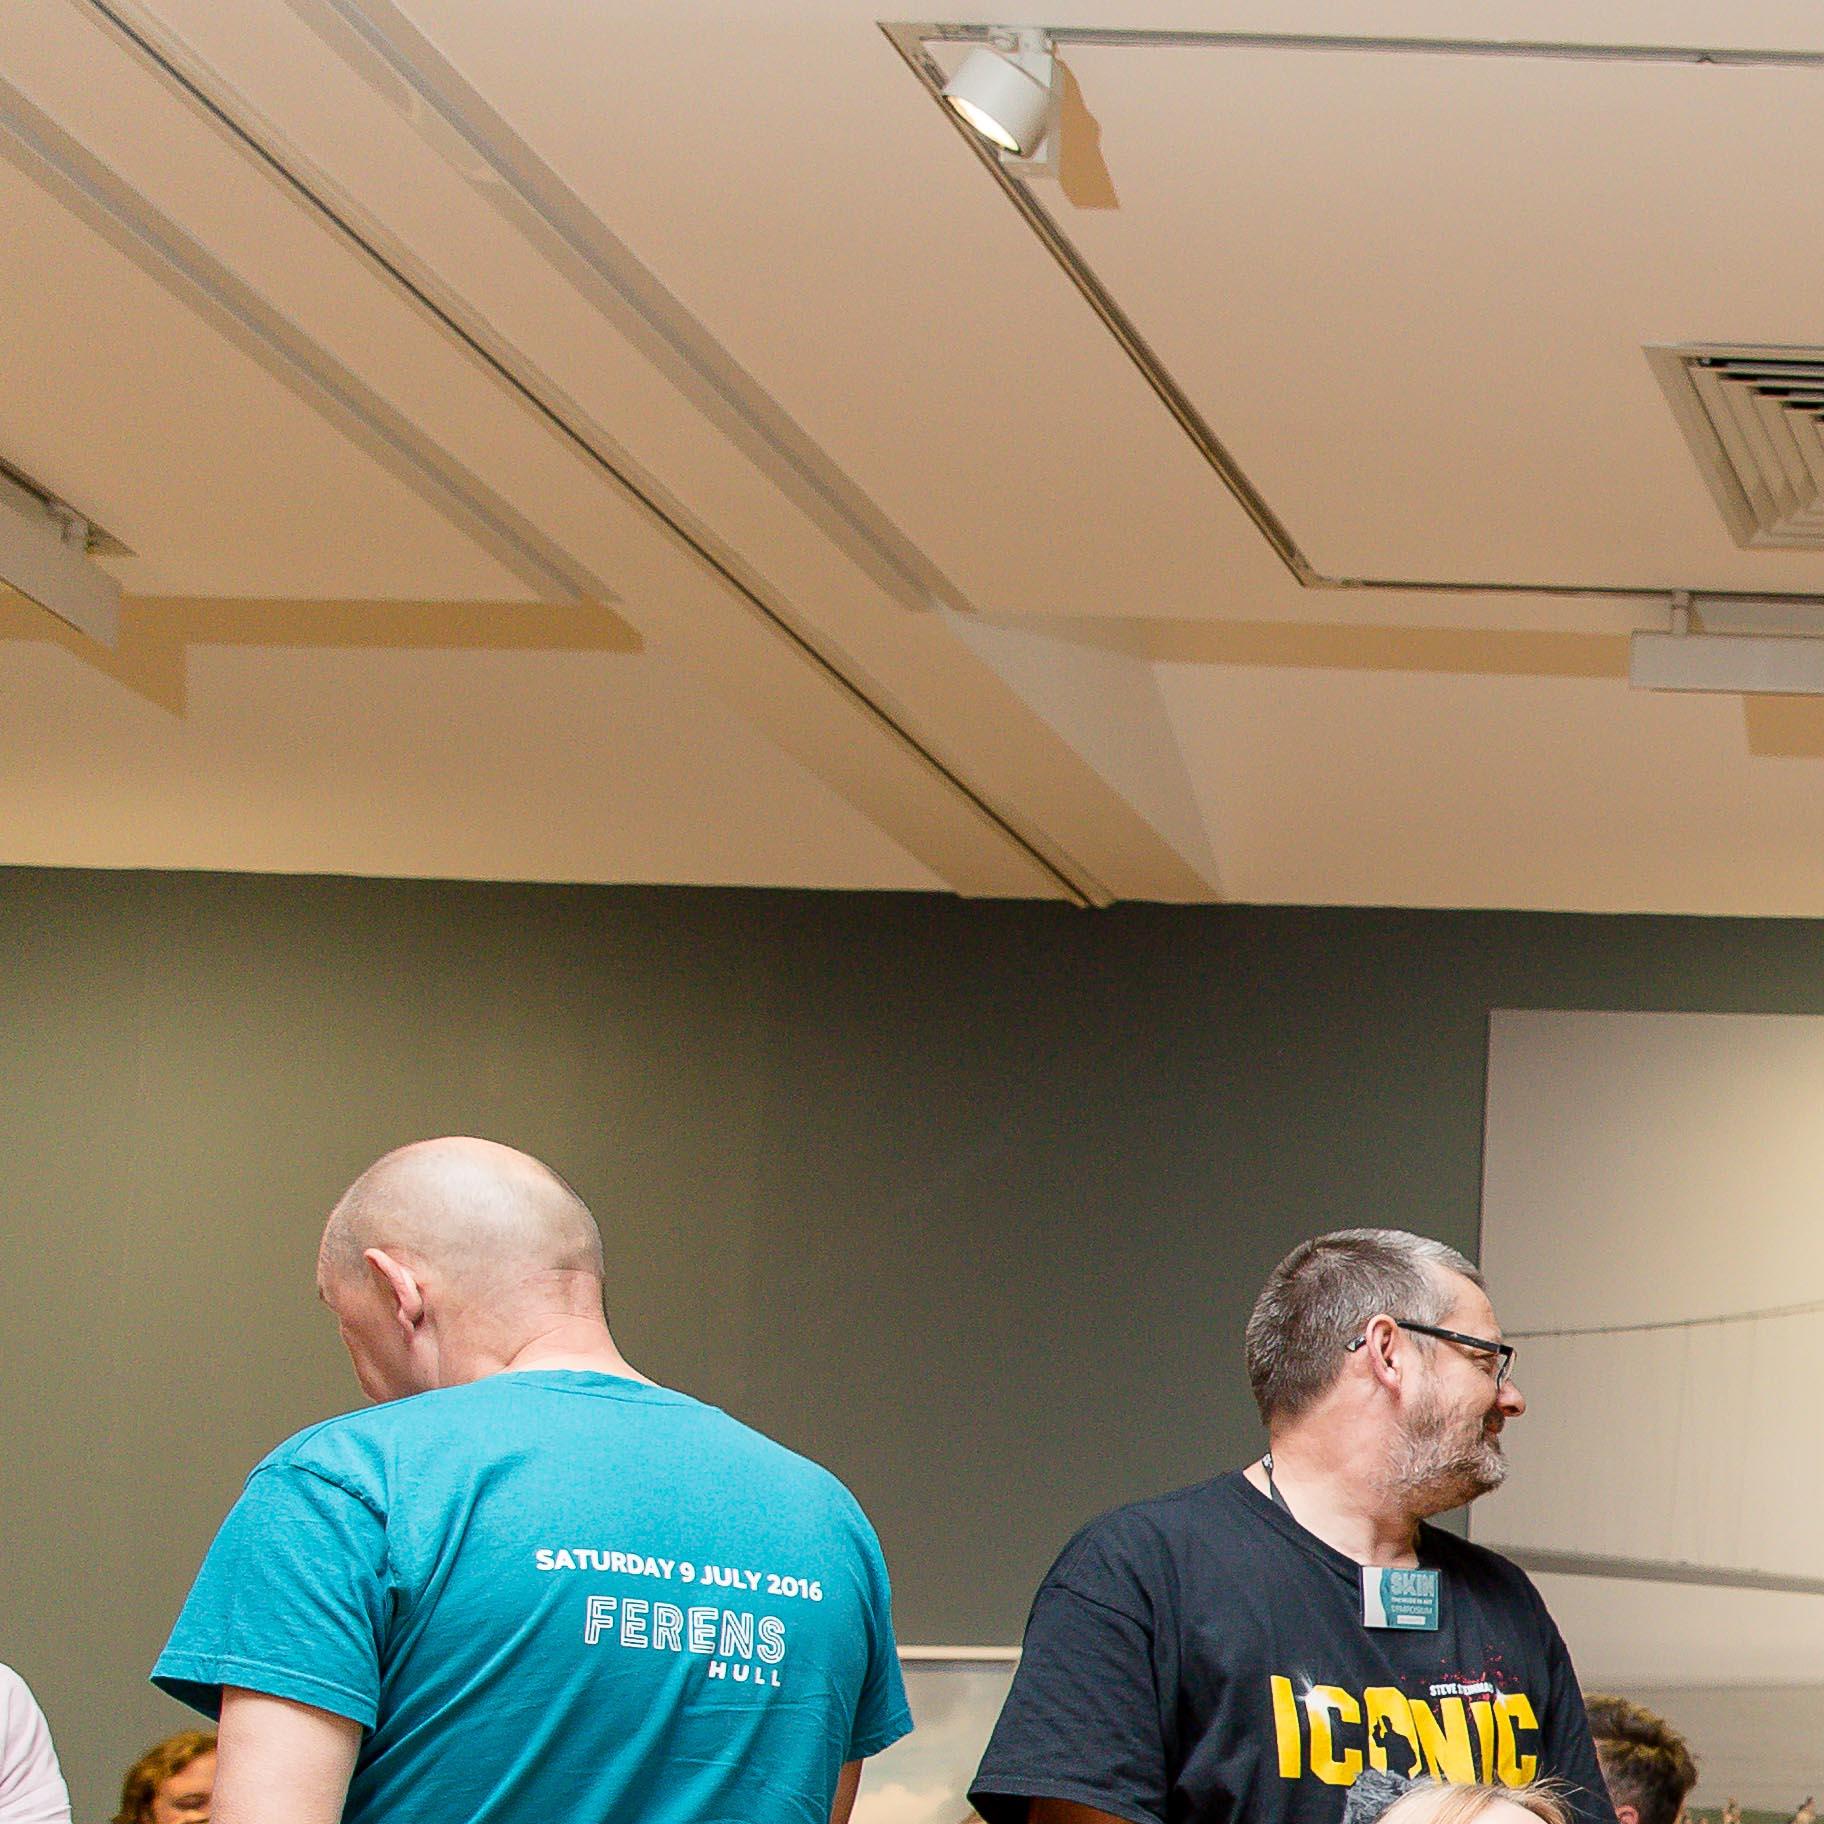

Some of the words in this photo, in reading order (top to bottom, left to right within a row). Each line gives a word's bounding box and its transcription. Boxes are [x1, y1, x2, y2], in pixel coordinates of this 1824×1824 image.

[535, 1548, 676, 1580] SATURDAY
[679, 1561, 696, 1583] 9
[700, 1565, 763, 1592] JULY
[766, 1573, 824, 1602] 2016
[584, 1595, 786, 1665] FERENS
[708, 1660, 781, 1688] HULL
[1270, 1674, 1539, 1790] ICONIC
